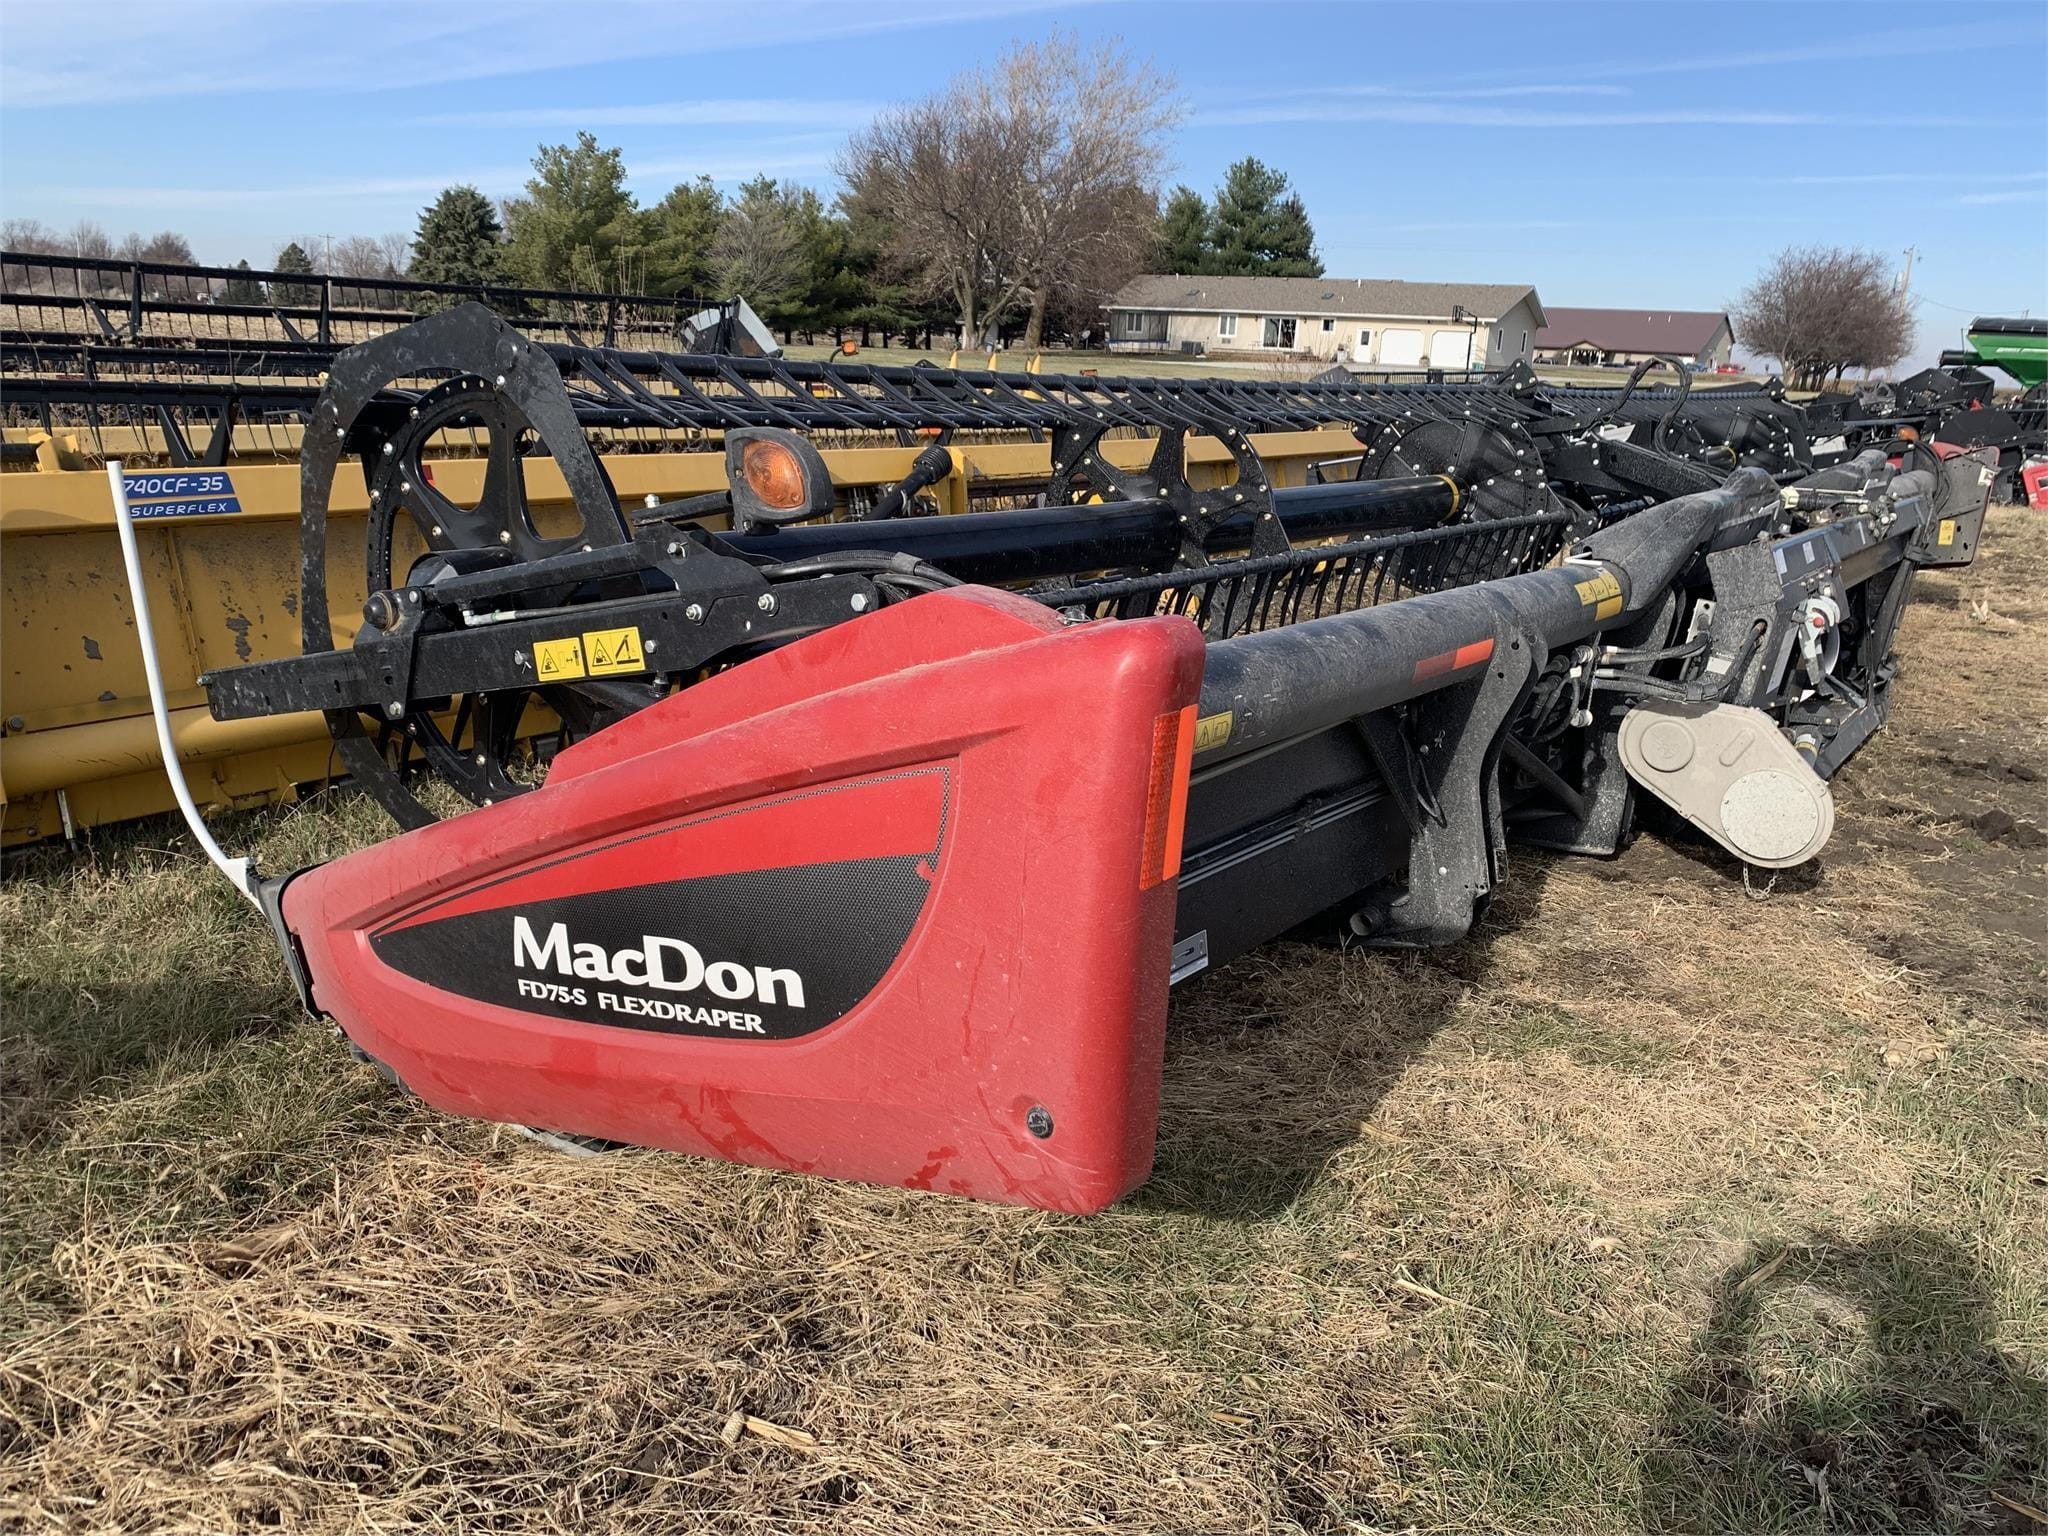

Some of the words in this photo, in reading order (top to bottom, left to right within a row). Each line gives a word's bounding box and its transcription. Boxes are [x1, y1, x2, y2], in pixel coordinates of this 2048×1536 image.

[131, 503, 227, 516] SUPERFLEX
[513, 915, 806, 1008] MacDon
[517, 979, 588, 1006] FD75-S
[597, 992, 766, 1034] FLEXDRAPER
